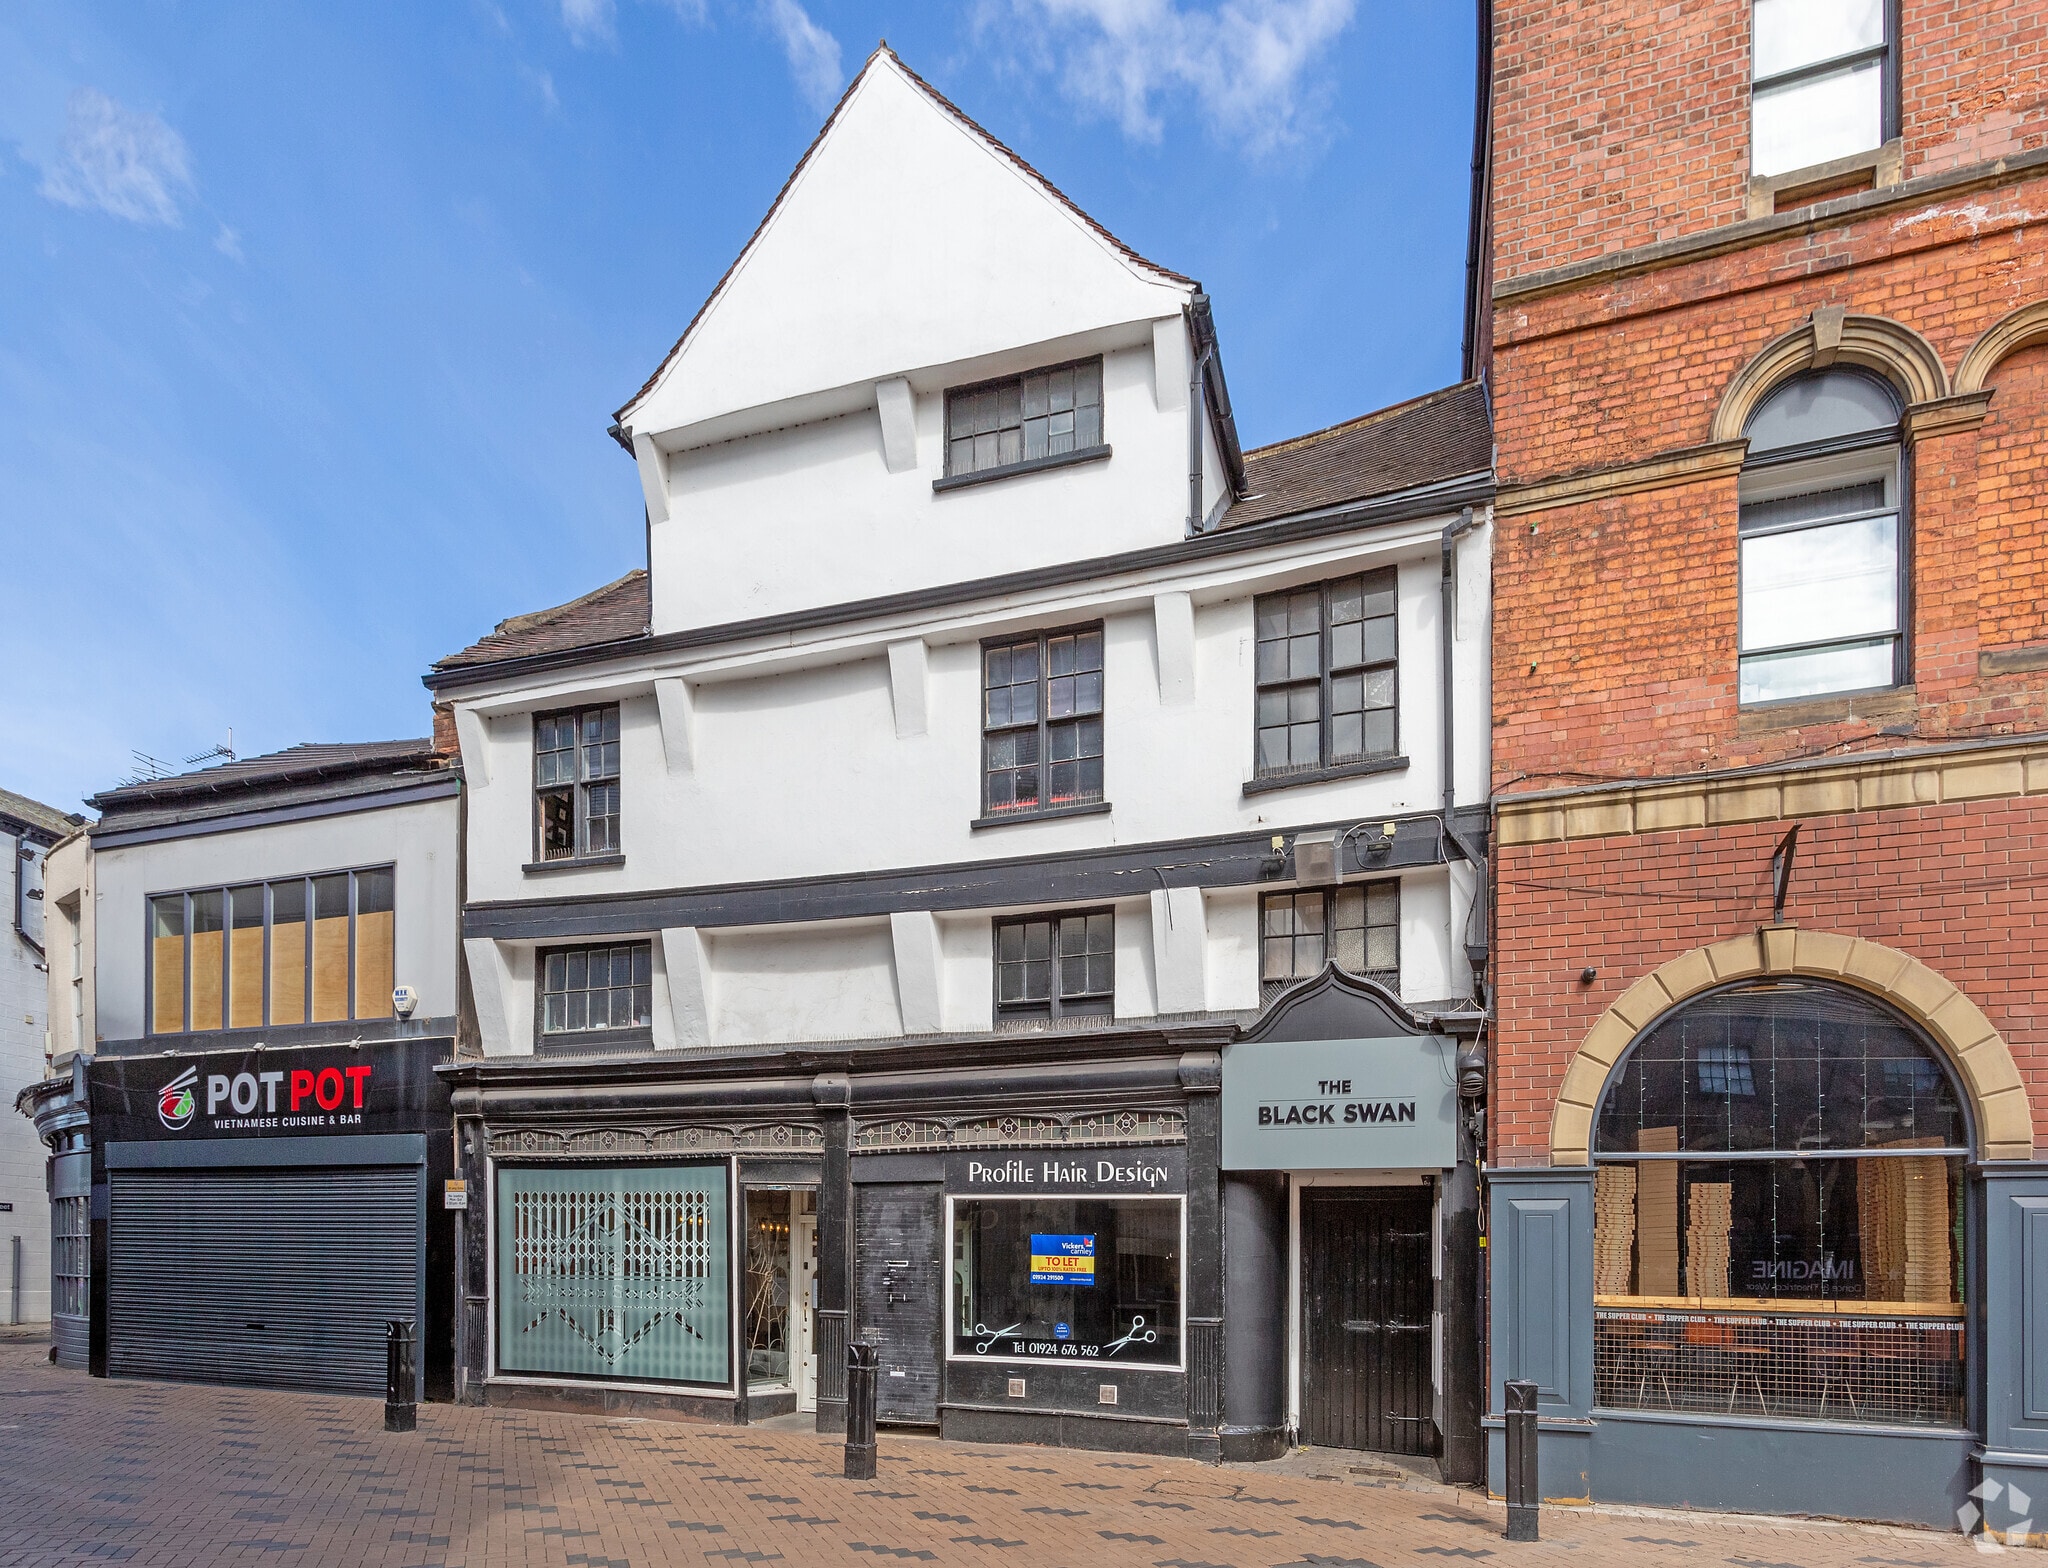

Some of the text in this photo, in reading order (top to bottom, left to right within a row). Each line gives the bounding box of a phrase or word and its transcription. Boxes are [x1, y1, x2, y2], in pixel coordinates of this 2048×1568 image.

[207, 1065, 372, 1115] POT POT
[1318, 1079, 1352, 1095] THE
[1258, 1101, 1416, 1125] BLACK SWAN
[214, 1114, 362, 1129] VIETNAMESE CUISINE & BAR
[1070, 1247, 1092, 1256] carnley
[1045, 1256, 1079, 1267] TO LET
[613, 1284, 682, 1300] Studio
[1596, 1311, 1607, 1319] THE
[1608, 1312, 1631, 1320] SUPPER
[1631, 1312, 1646, 1320] CLUB
[1654, 1313, 1666, 1321] THE
[1666, 1314, 1689, 1322] SUPPER
[1690, 1315, 1705, 1323] CLUB
[1714, 1316, 1726, 1324] THE
[1726, 1317, 1750, 1325] SUPPER
[1775, 1318, 1787, 1326] THE
[1788, 1318, 1813, 1326] SUPPER
[1813, 1319, 1830, 1327] CLUB
[1839, 1320, 1852, 1328] THE
[1852, 1320, 1878, 1328] SUPPER
[1878, 1321, 1896, 1329] CLUB
[1905, 1321, 1919, 1329] THE
[1919, 1322, 1945, 1330] SUPPER
[1946, 1322, 1964, 1330] CLUB
[1012, 1341, 1099, 1357] Tel 01924 676 562
